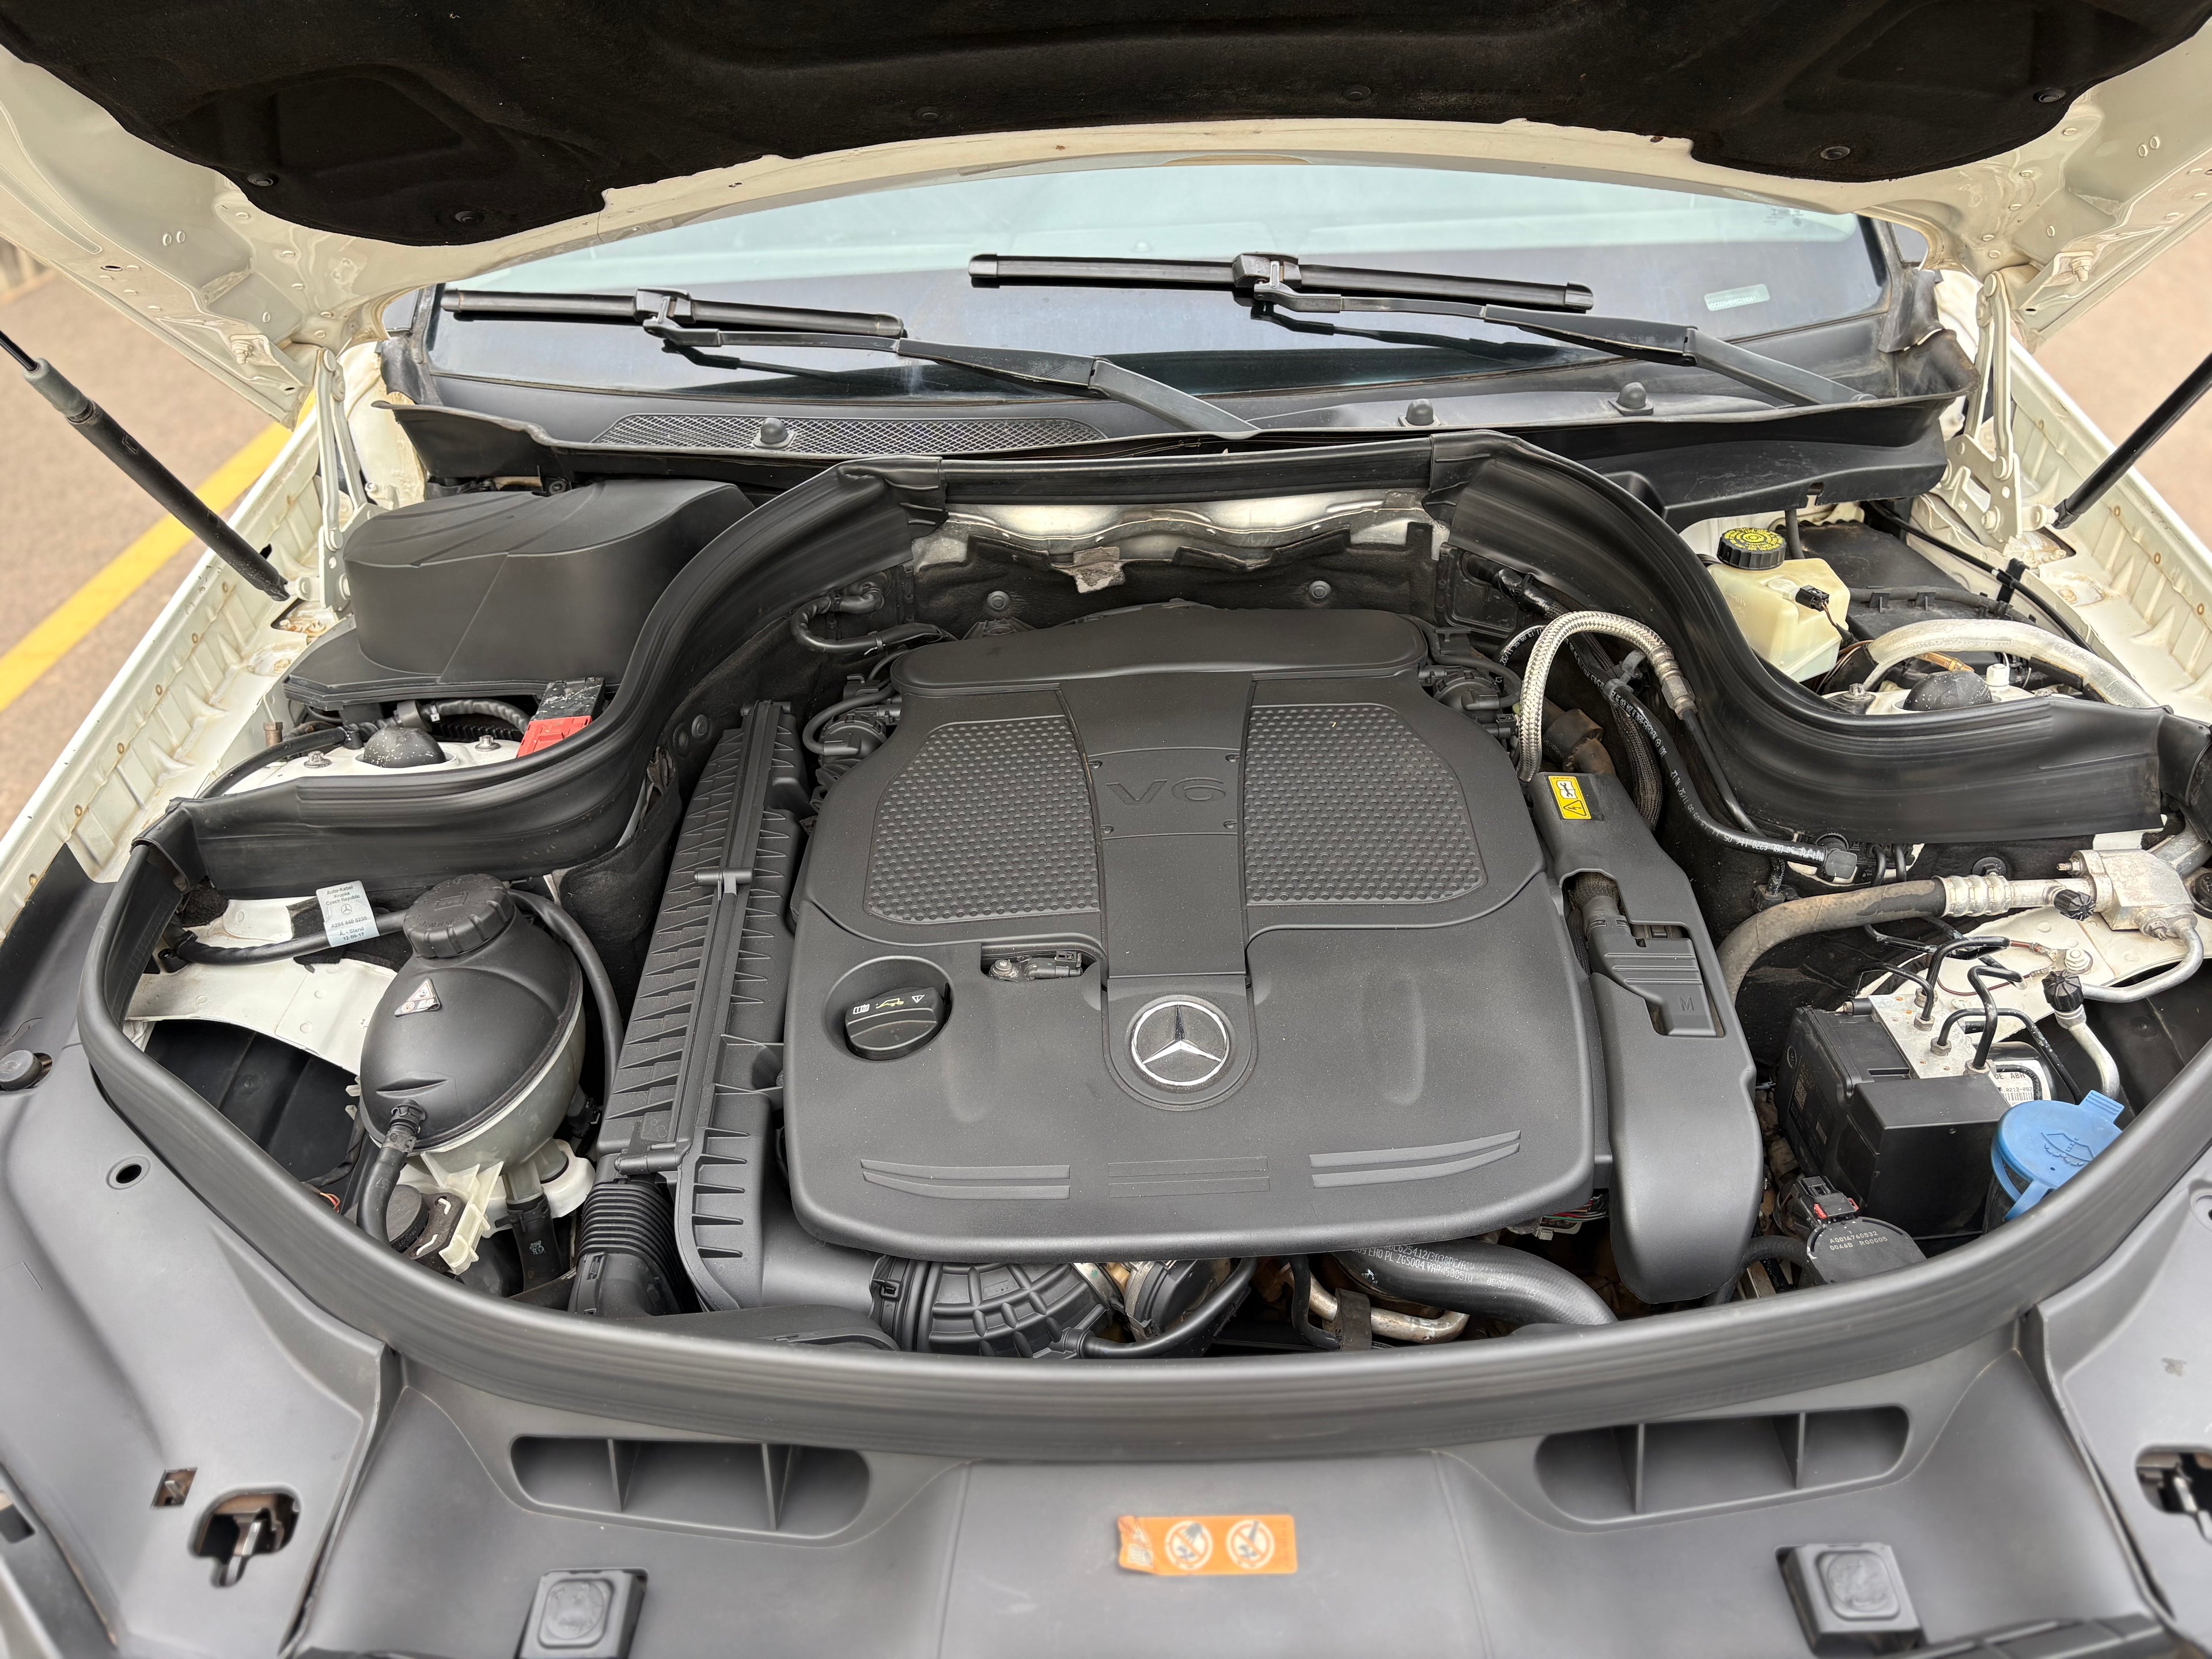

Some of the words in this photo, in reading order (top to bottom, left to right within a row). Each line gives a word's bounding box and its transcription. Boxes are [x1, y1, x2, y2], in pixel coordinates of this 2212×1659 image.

[1106, 777, 1226, 805] V6
[1724, 835, 1732, 843] 05
[327, 885, 354, 895] Auto-Kabel
[1679, 998, 1694, 1011] M
[1385, 1251, 1395, 1261] PL
